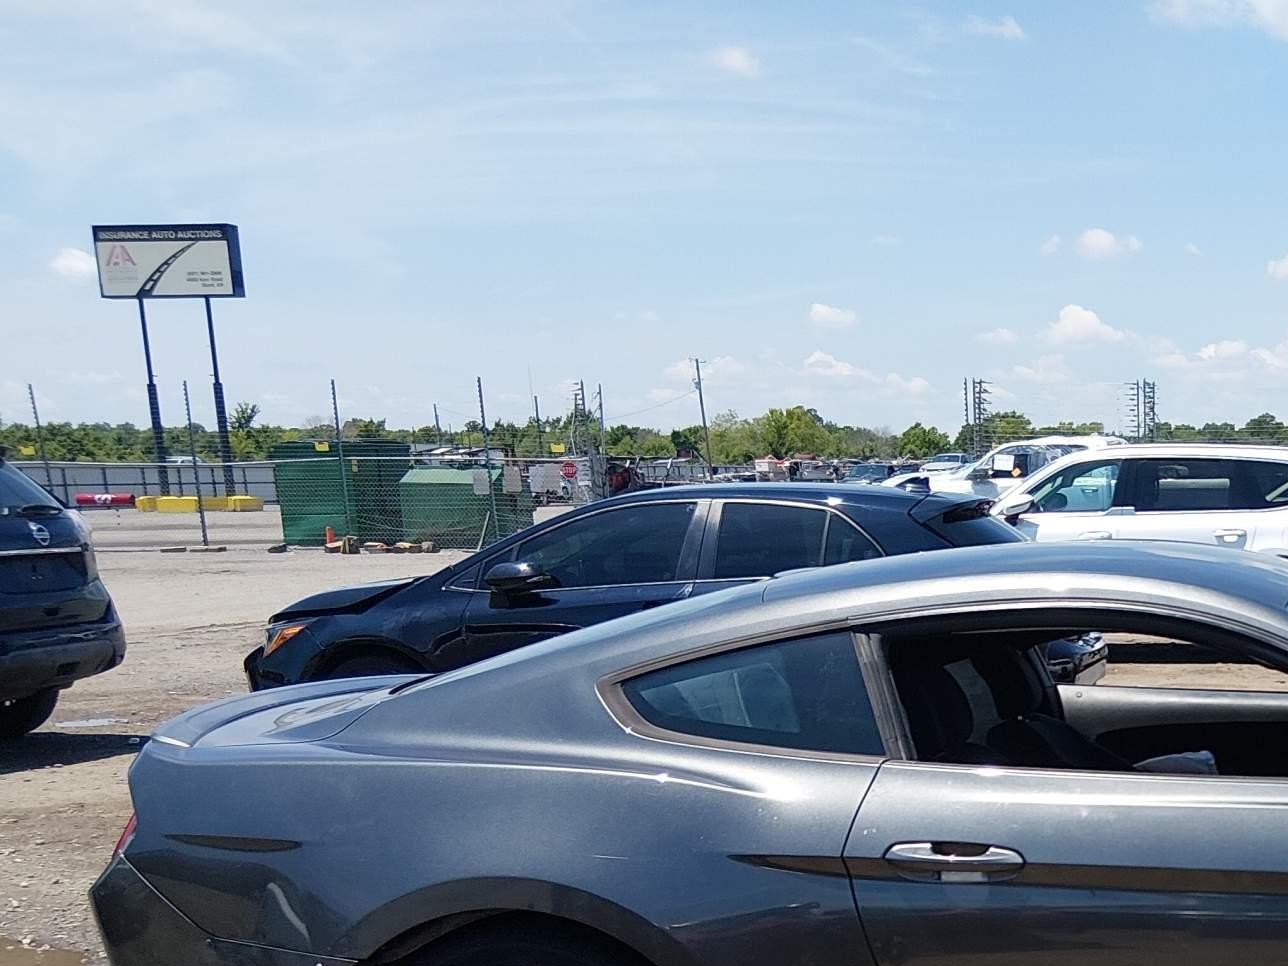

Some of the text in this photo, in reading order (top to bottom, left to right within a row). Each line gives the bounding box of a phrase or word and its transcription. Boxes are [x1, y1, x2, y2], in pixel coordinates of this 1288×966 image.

[99, 230, 223, 239] INSURANCE AUTO AUCTIONS
